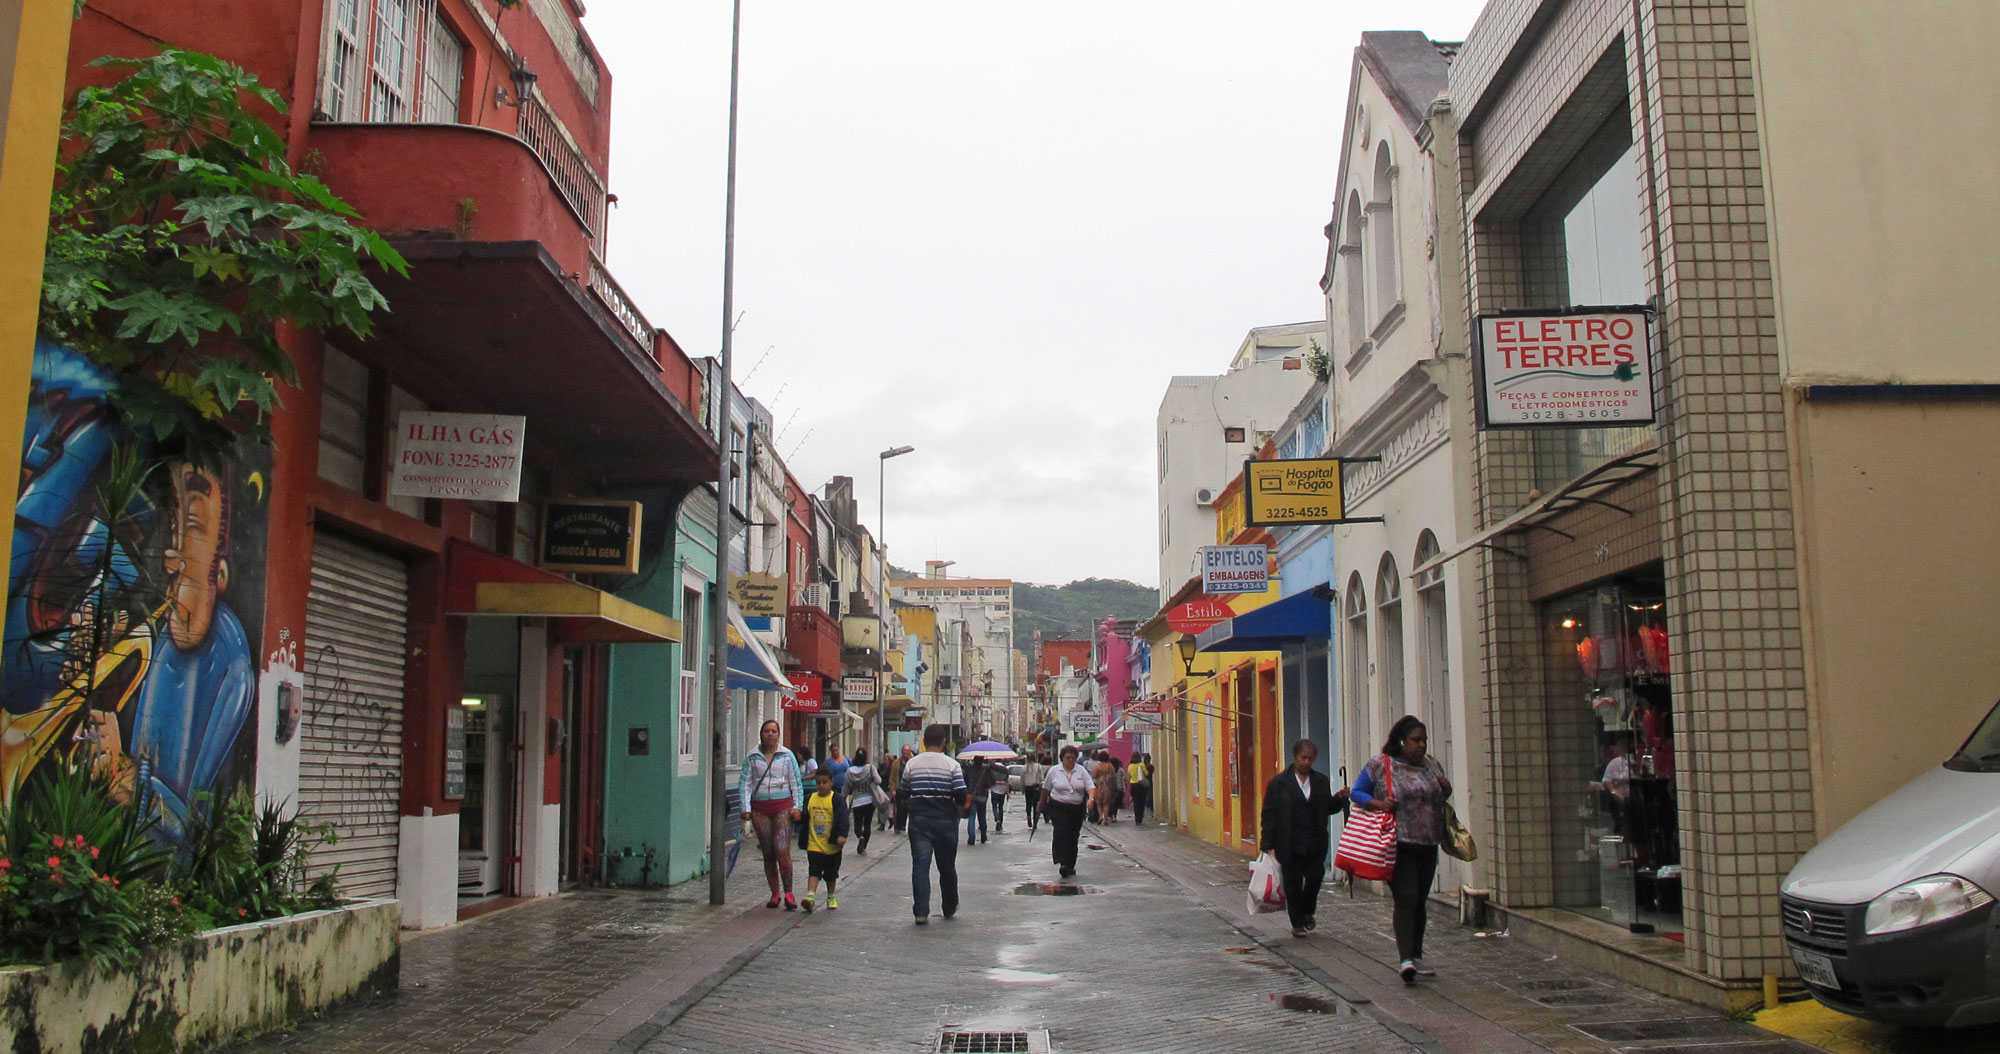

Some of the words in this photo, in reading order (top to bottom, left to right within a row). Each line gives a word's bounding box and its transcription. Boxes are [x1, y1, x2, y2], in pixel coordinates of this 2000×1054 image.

[1496, 318, 1634, 343] ELETRO
[1496, 344, 1635, 369] TERRES
[1499, 392, 1537, 402] PEÇAS
[1552, 390, 1620, 399] CONSERTOS
[1624, 389, 1639, 397] DE
[1511, 399, 1629, 410] ELETRODOMÉSTICOS
[408, 424, 462, 442] ILHA
[469, 424, 513, 445] GÁS
[401, 450, 445, 465] FONE
[447, 453, 516, 470] 3225-2877
[402, 475, 454, 484] CONSERTO
[456, 477, 467, 485] DE
[1286, 466, 1333, 481] Hospital
[438, 487, 481, 495] PANELAS
[1297, 478, 1334, 493] Fogão
[1266, 507, 1328, 519] 3225-4525
[553, 511, 622, 533] RESTAURANTE
[551, 545, 585, 556] CARIOCA
[586, 547, 597, 557] DA
[599, 548, 621, 558] GEMA
[1207, 547, 1264, 567] EPITÉLOS
[1209, 570, 1265, 581] EMBALAGENS
[1185, 602, 1222, 618] Estilo
[793, 682, 809, 693] só
[784, 695, 792, 707] 2
[795, 698, 818, 707] reais
